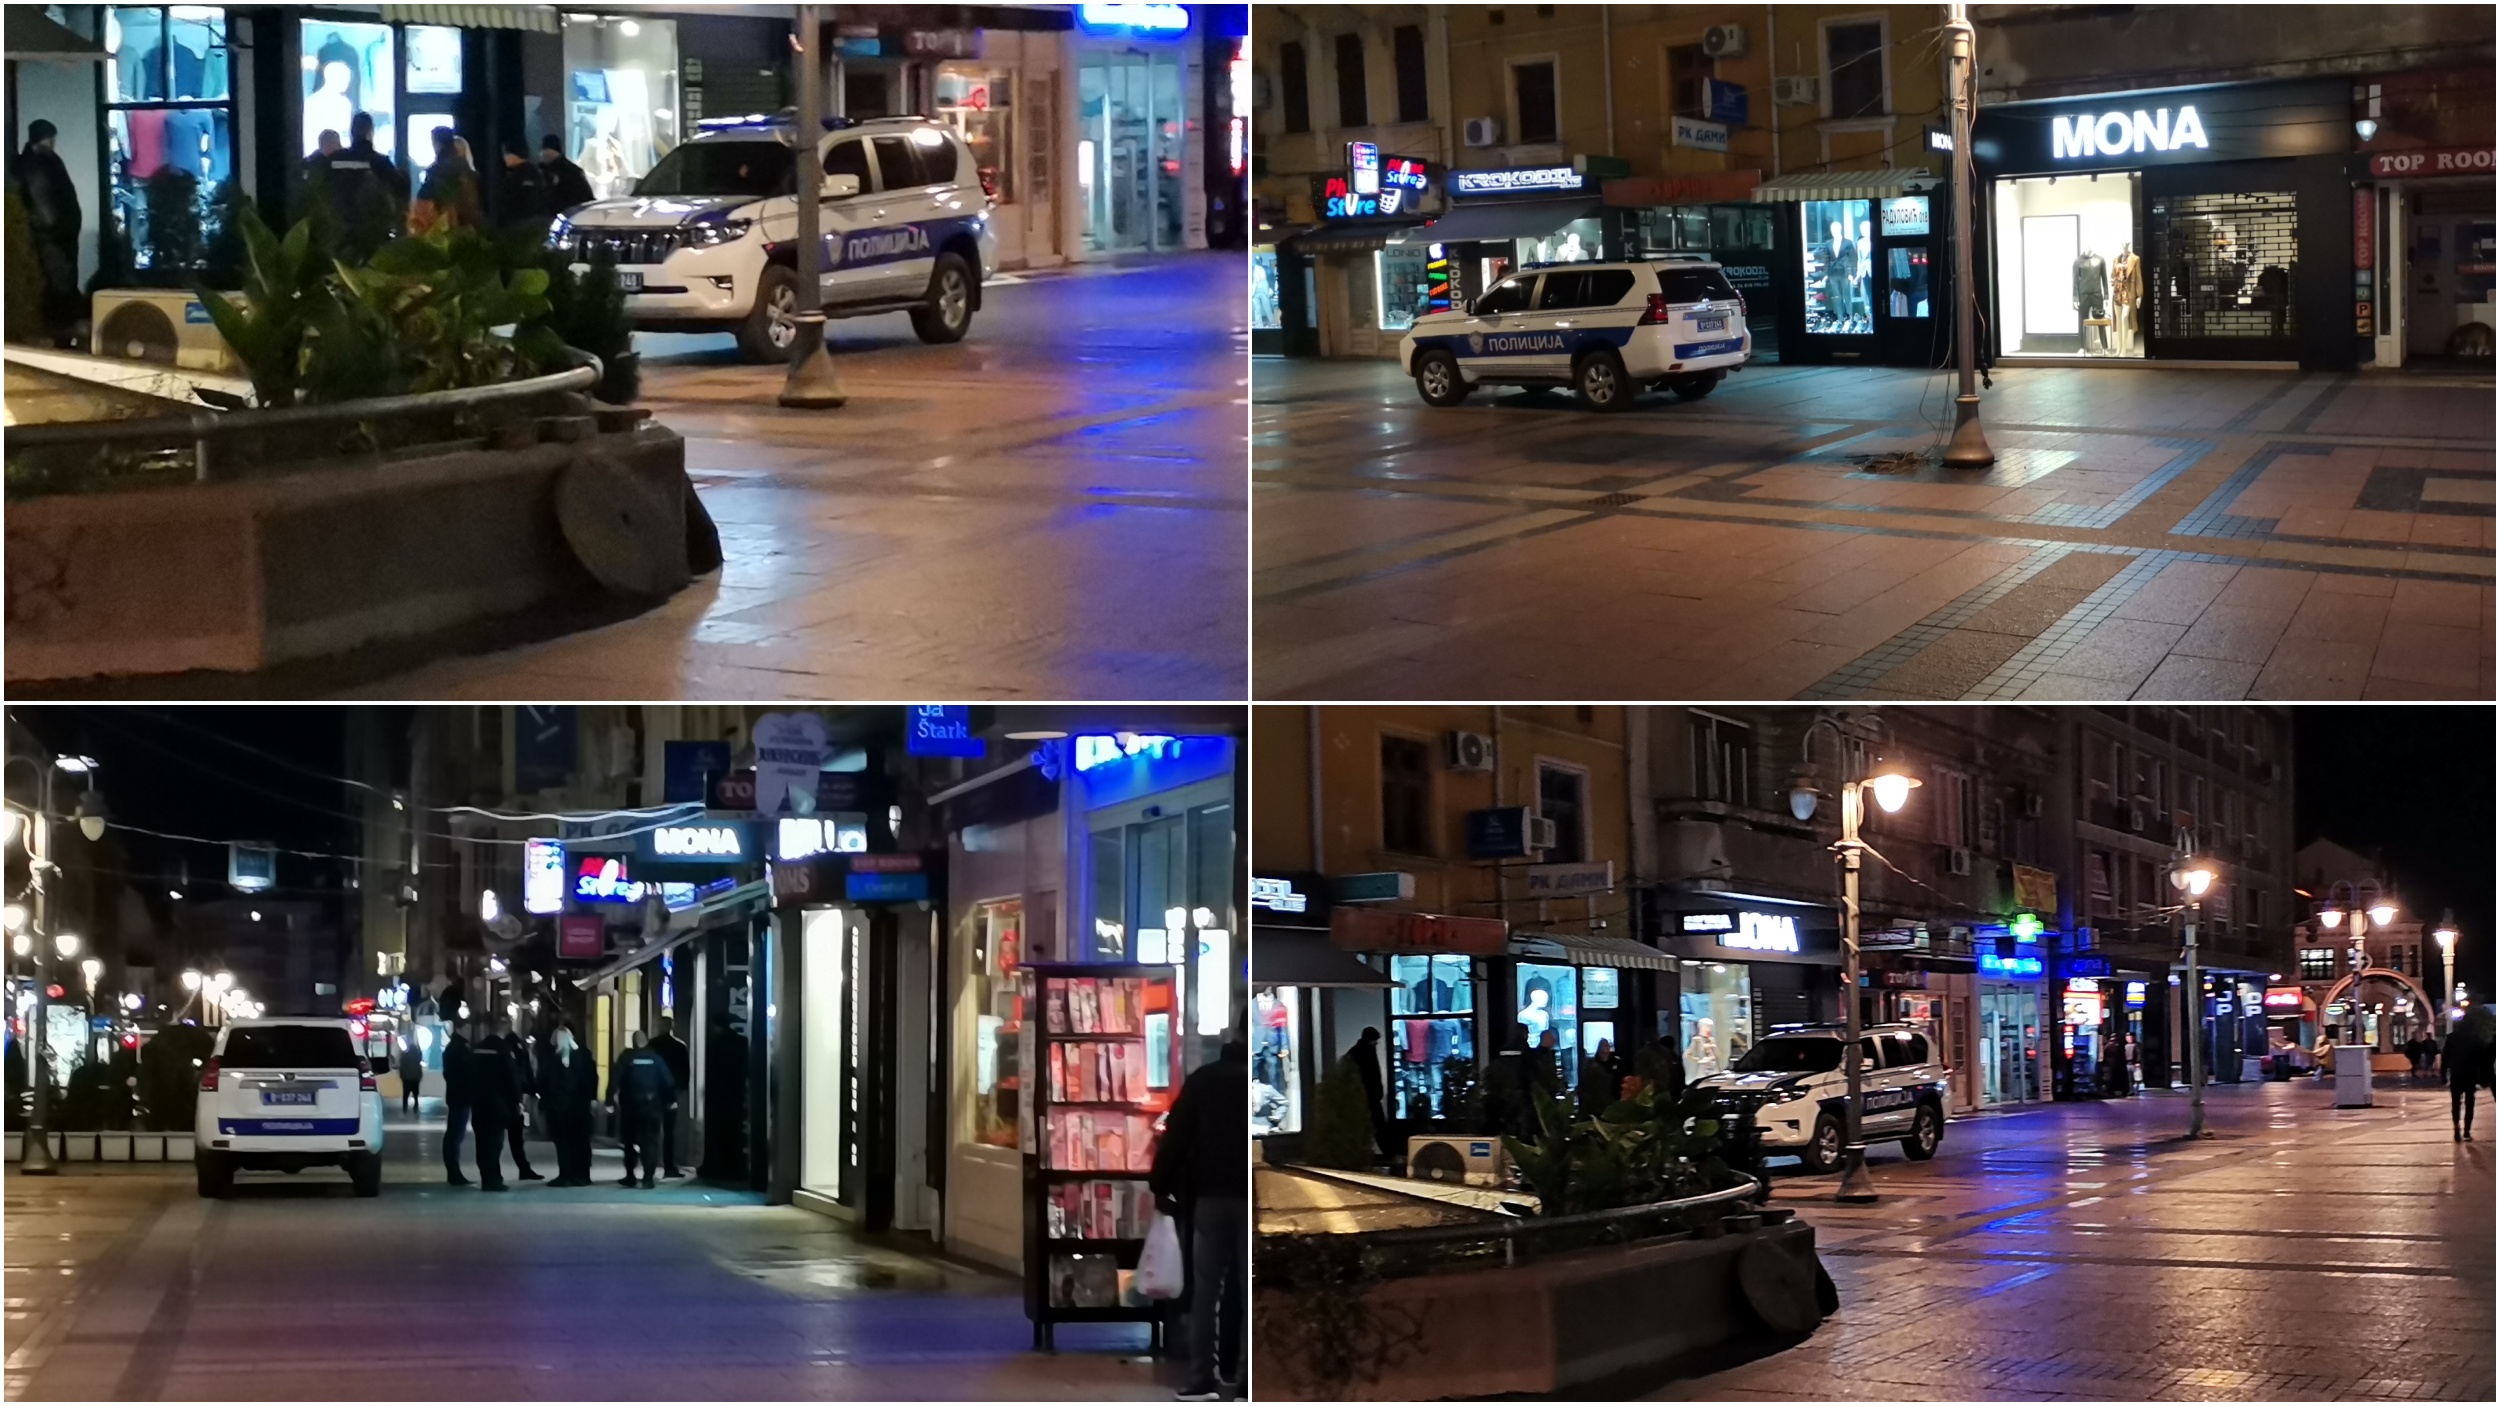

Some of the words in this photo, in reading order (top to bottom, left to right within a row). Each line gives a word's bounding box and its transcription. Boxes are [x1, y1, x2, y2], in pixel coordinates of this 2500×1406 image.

[2053, 106, 2209, 158] MONA
[2380, 154, 2425, 172] TOP
[1459, 168, 1581, 191] KROKODIL
[1720, 266, 1769, 277] KROKODIL
[1488, 335, 1564, 351] ПОЛИЦИЈА
[918, 717, 967, 739] Štark
[654, 828, 741, 855] MONA
